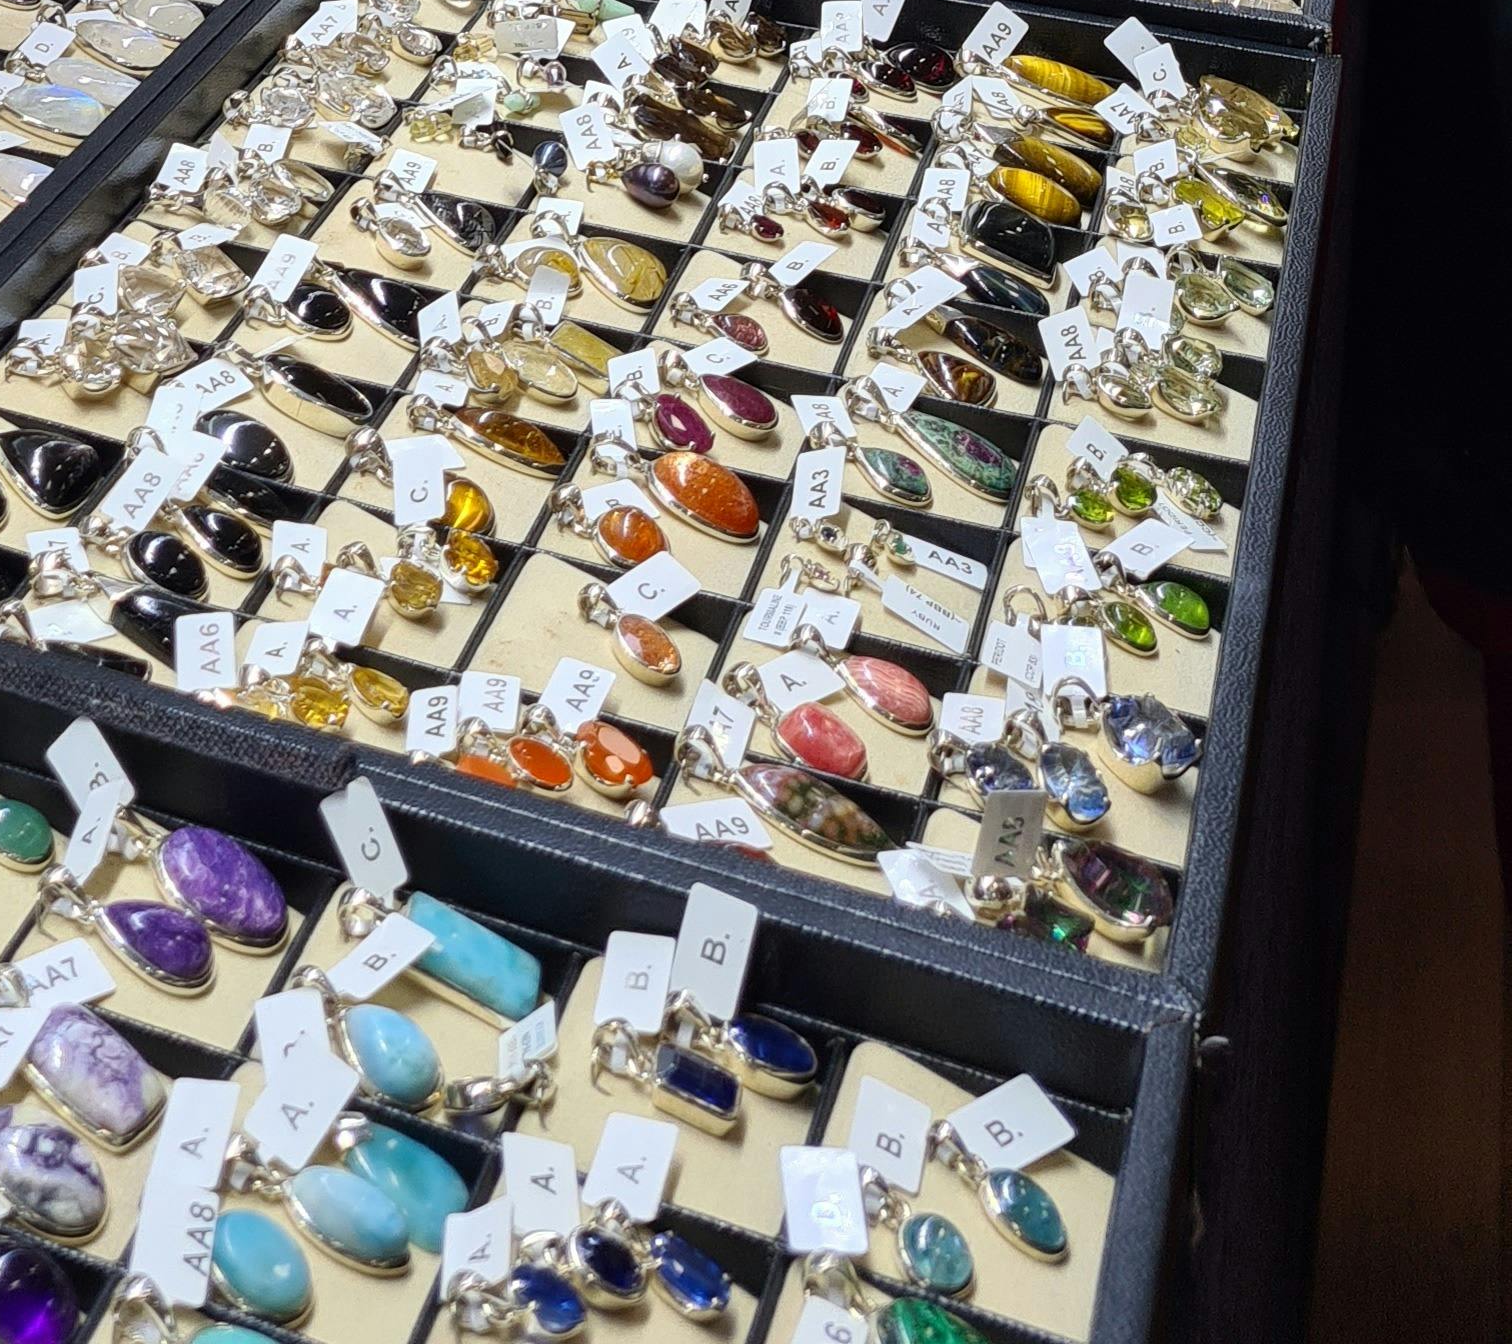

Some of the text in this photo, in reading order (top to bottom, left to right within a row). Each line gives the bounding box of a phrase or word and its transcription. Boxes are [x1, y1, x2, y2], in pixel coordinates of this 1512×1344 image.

[123, 473, 161, 519] AA8
[808, 469, 829, 508] AA3
[984, 1120, 1023, 1147] B.
[183, 1203, 216, 1277] AA8
